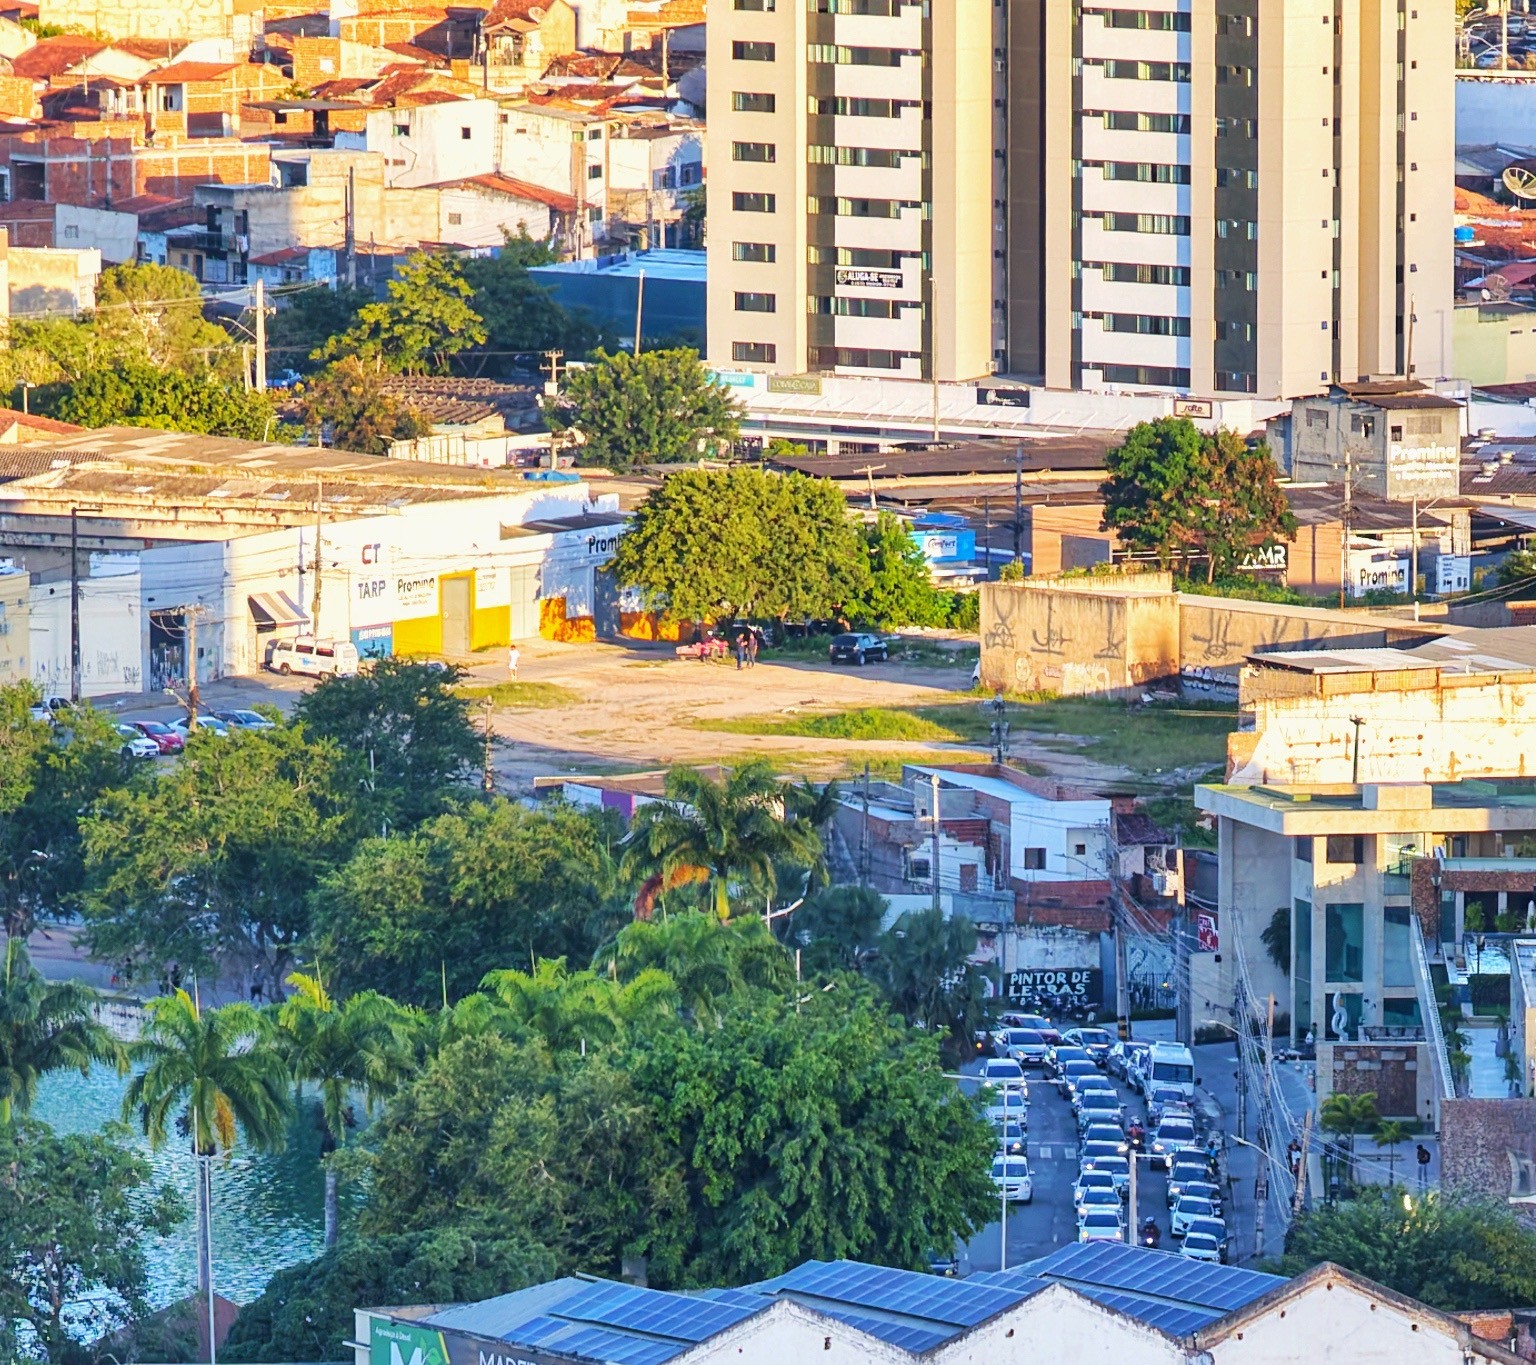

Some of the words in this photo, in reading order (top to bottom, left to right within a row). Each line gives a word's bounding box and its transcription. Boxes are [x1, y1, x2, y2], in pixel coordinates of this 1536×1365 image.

[361, 543, 381, 565] CT
[397, 577, 435, 594] Promina
[1360, 566, 1405, 587] Promina
[358, 579, 386, 600] TARP
[1010, 971, 1067, 985] PINTOR
[1071, 971, 1091, 984] DE
[1008, 983, 1086, 997] LETRAS
